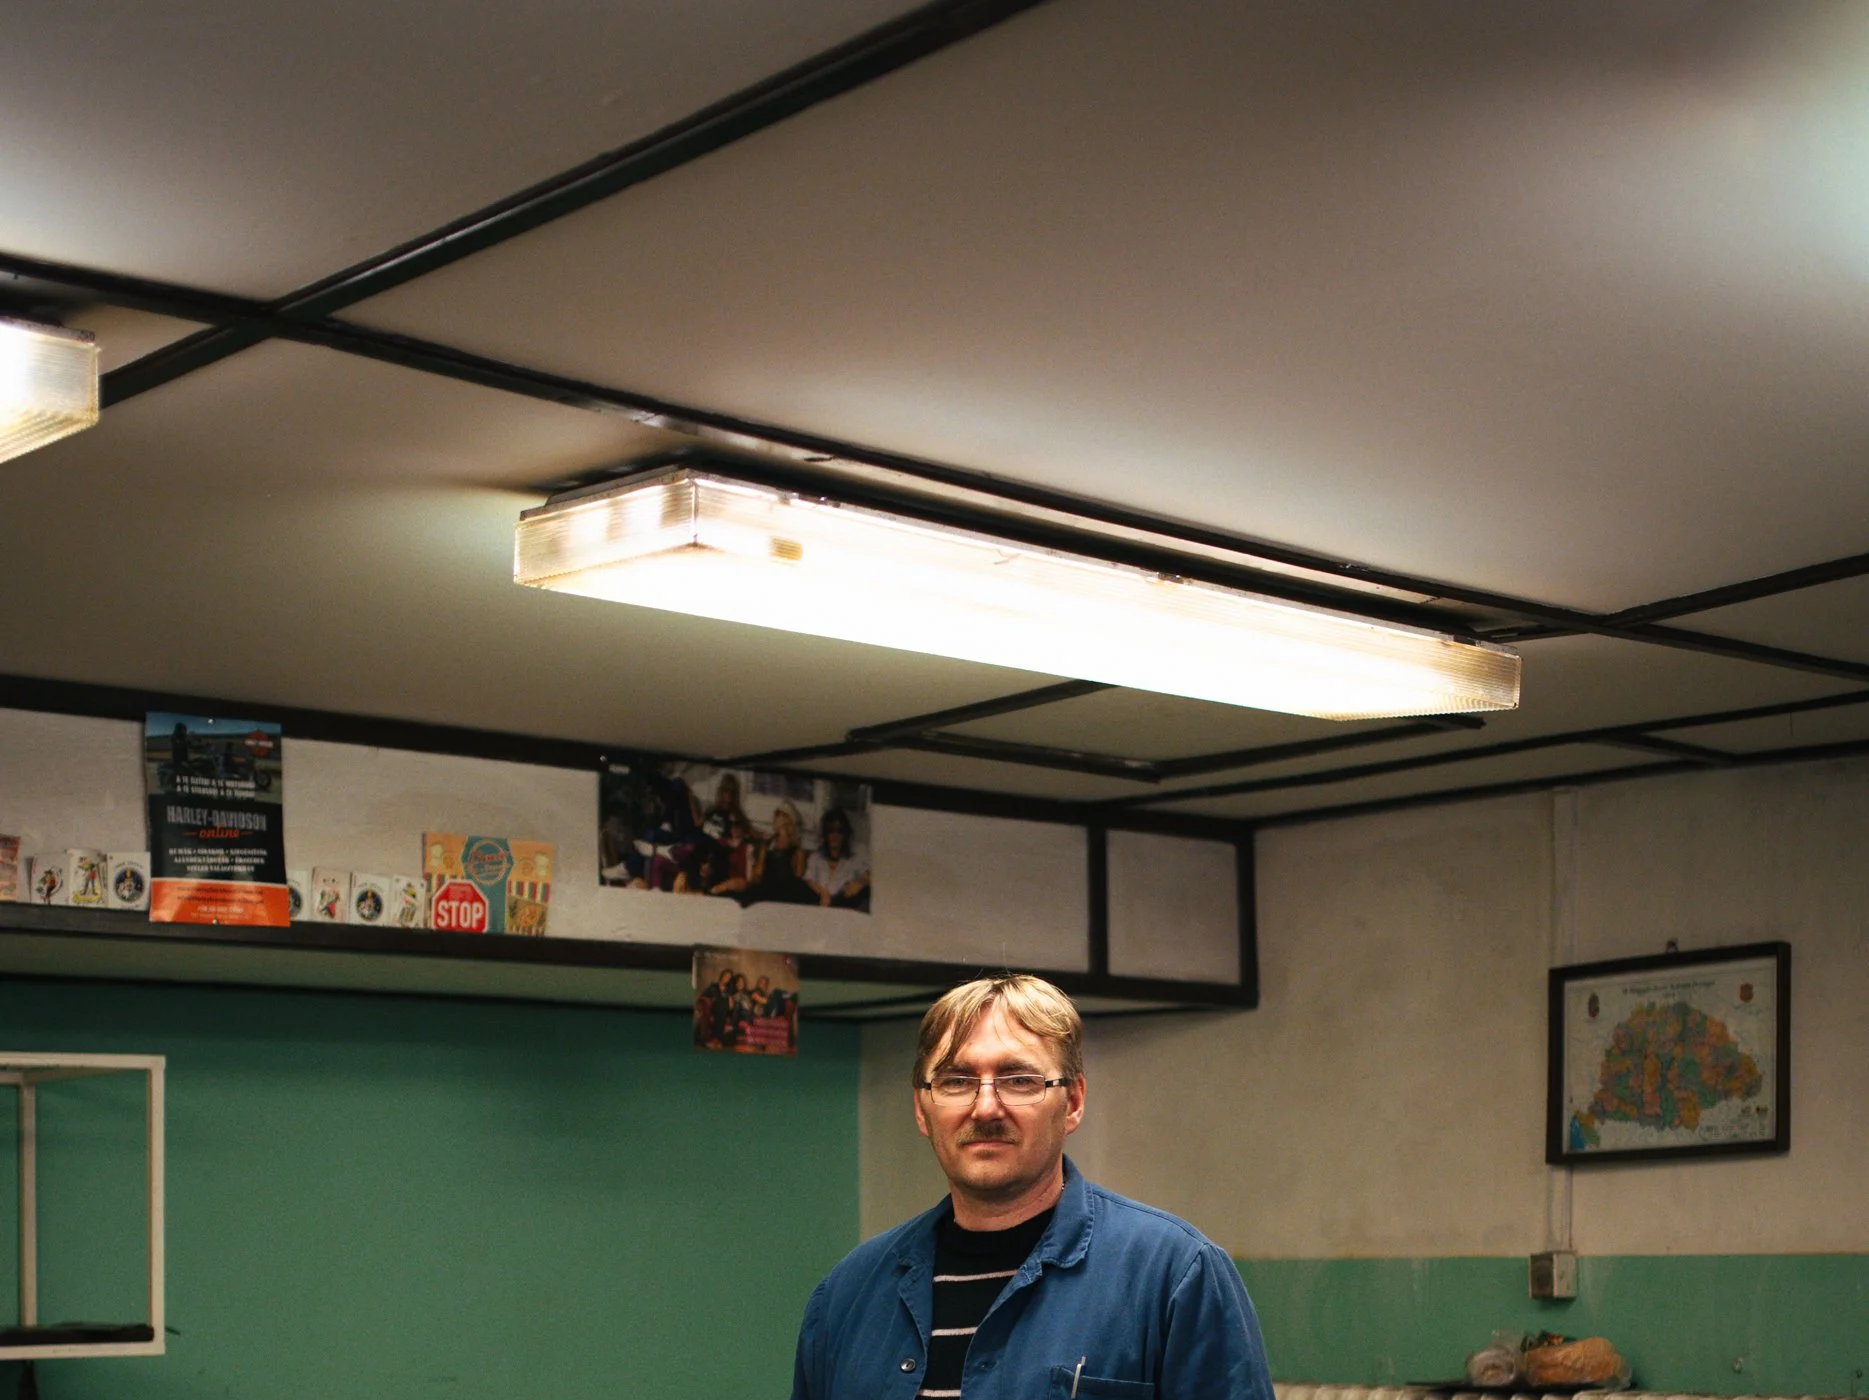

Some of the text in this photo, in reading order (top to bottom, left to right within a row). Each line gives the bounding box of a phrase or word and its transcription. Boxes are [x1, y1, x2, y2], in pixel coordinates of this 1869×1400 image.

[166, 805, 267, 831] HARLEY-DAVIDSON
[198, 824, 240, 841] online
[437, 900, 484, 930] STOP
